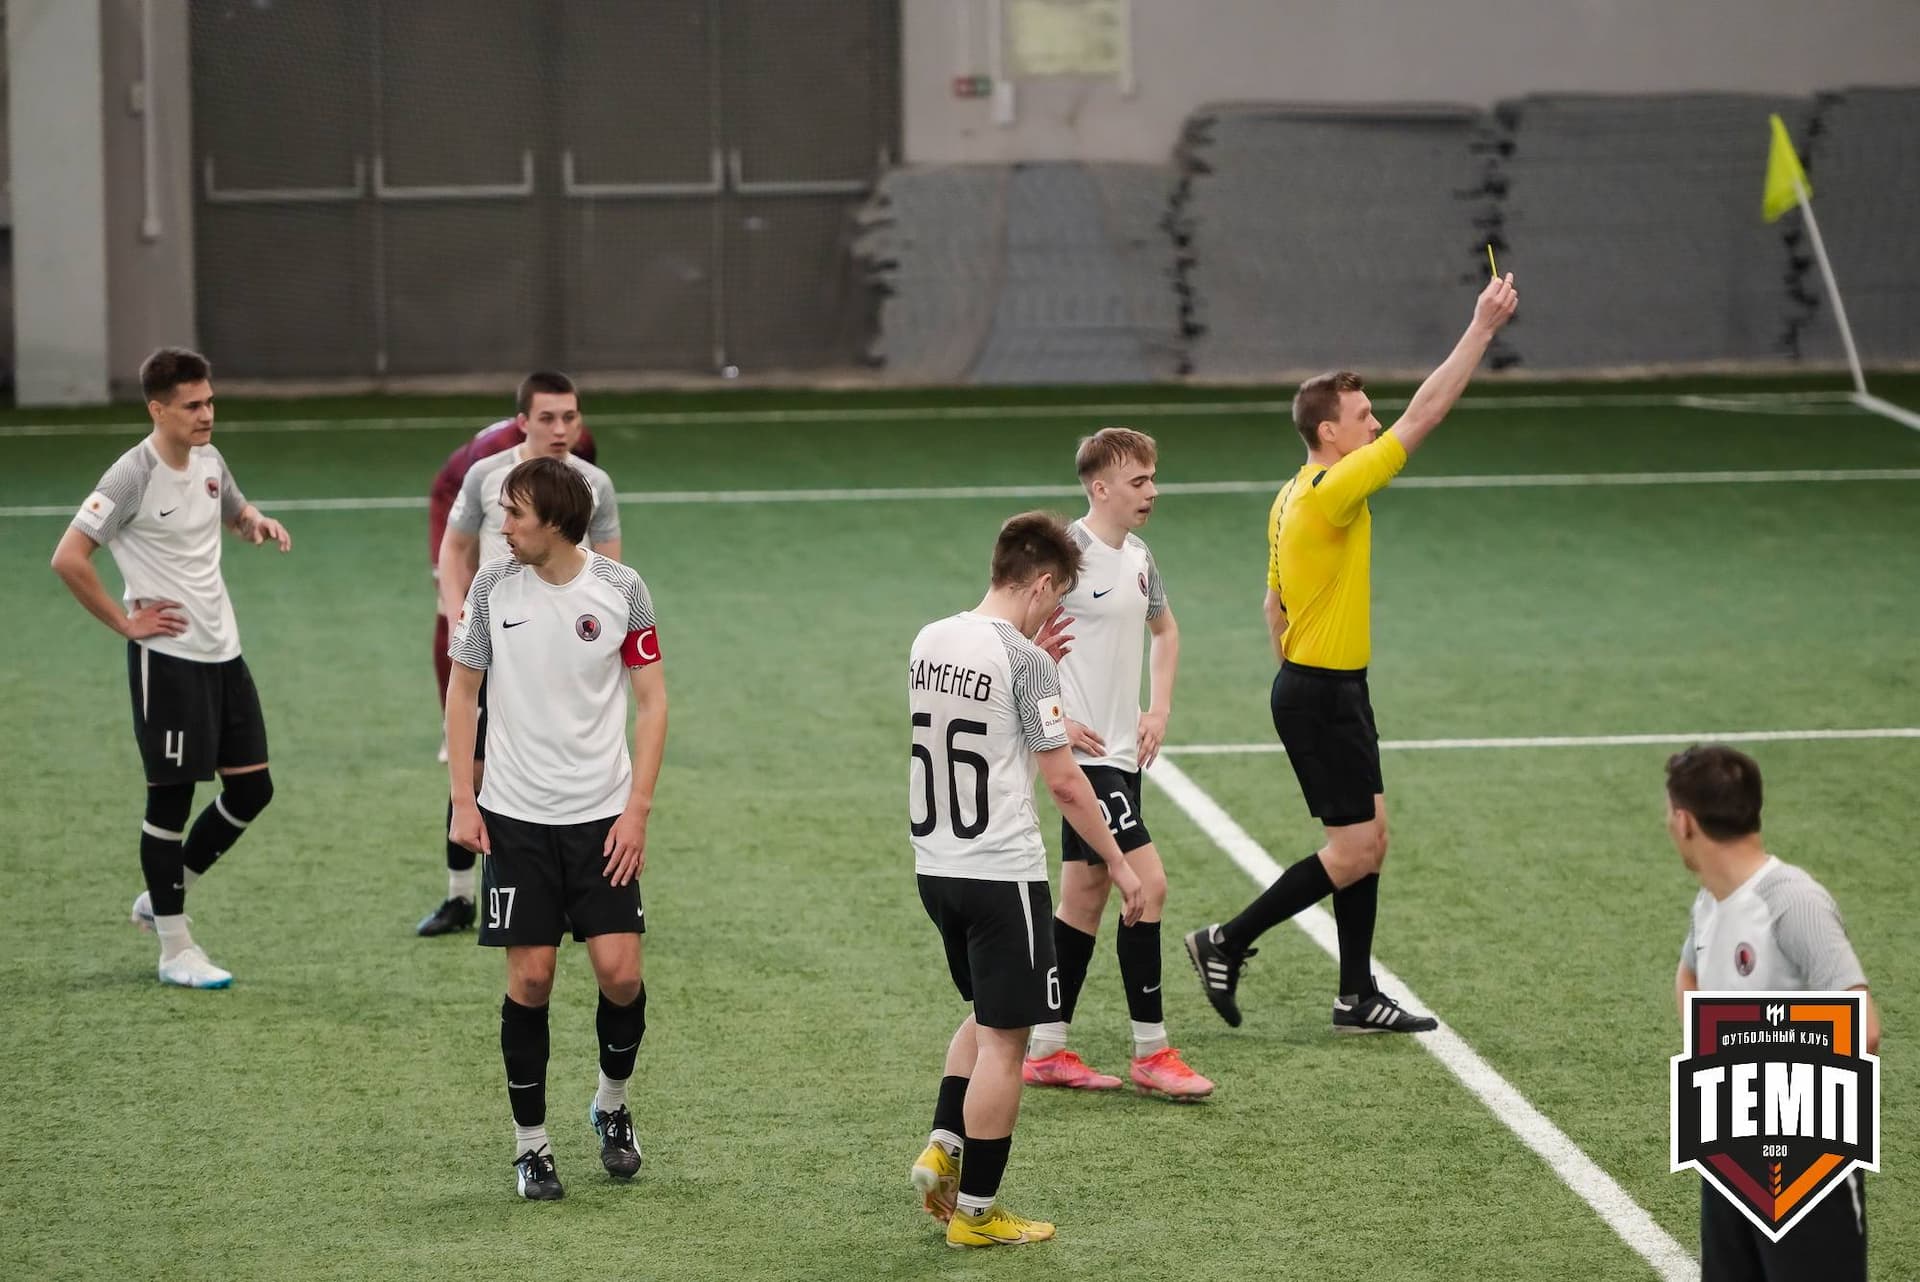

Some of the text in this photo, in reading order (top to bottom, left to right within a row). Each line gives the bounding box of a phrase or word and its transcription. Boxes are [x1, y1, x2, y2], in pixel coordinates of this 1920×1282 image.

[637, 630, 657, 660] C
[165, 730, 184, 767] 4
[488, 887, 516, 929] 97
[1046, 966, 1061, 1010] 6
